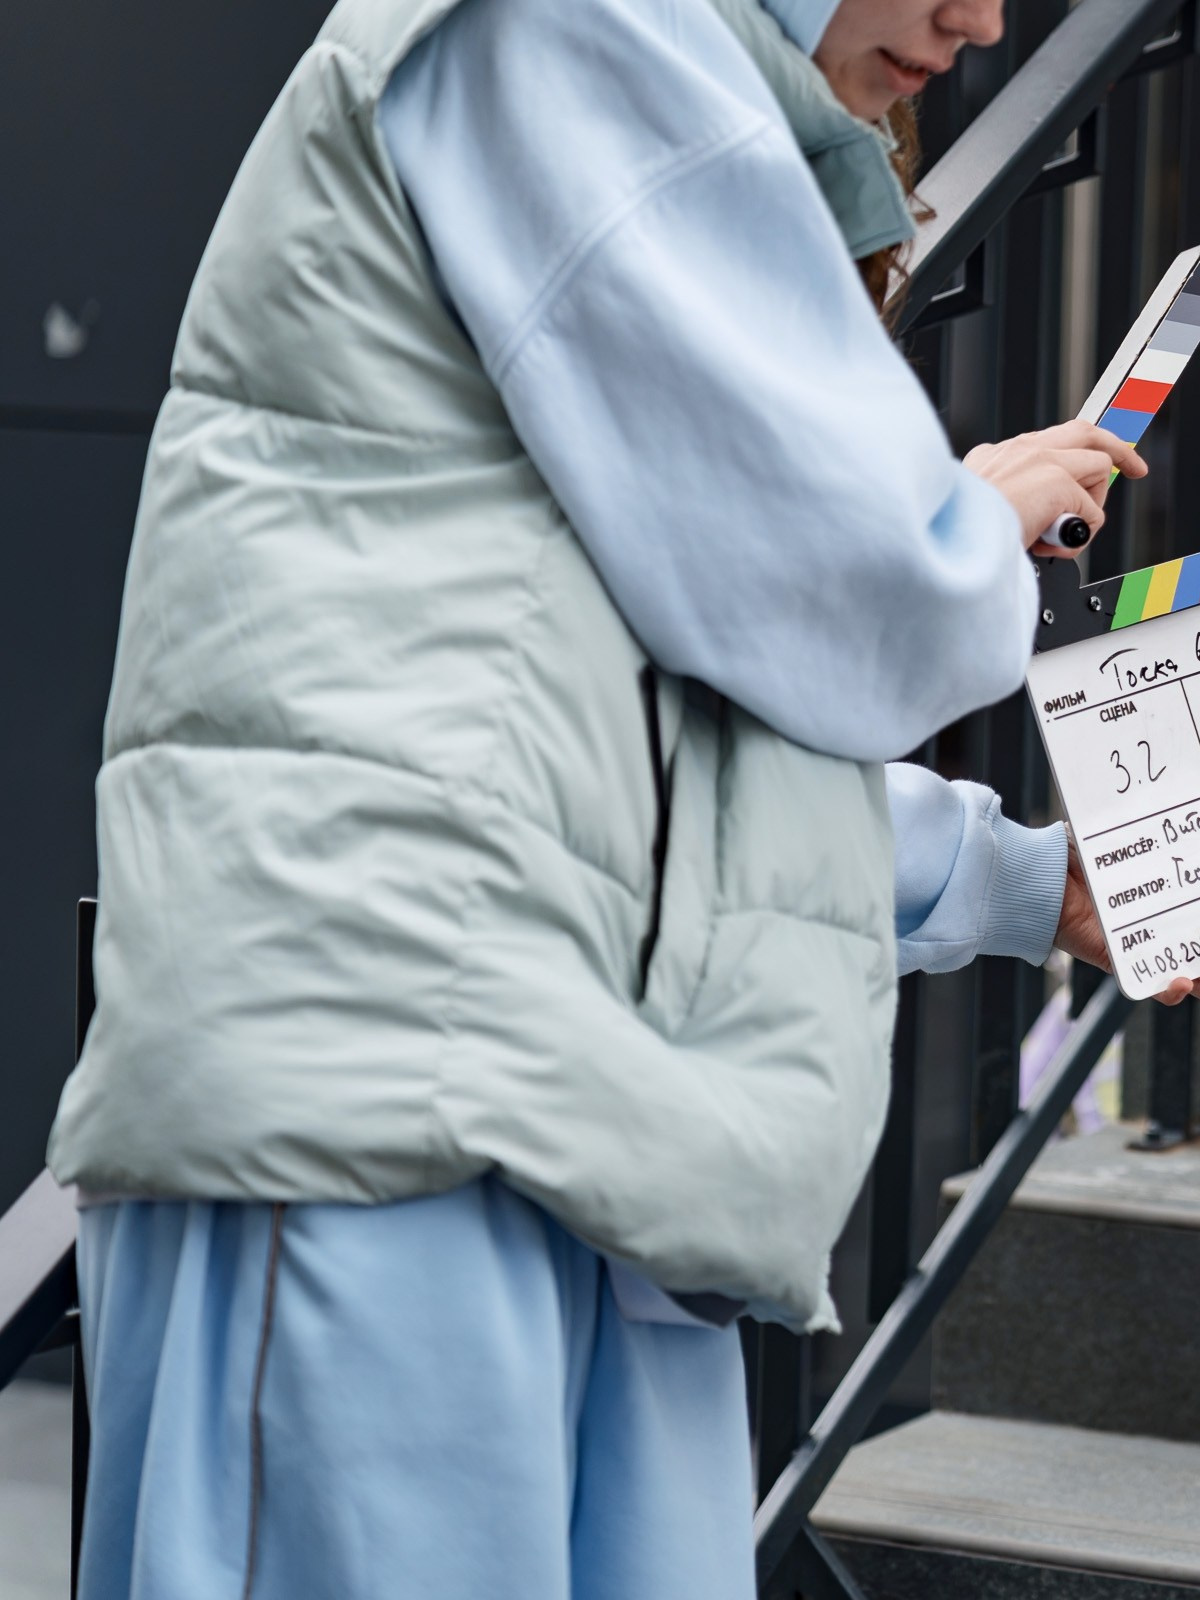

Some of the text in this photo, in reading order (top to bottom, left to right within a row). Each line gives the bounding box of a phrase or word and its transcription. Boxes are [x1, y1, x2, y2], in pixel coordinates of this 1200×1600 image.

[1044, 690, 1087, 714] ФИЛЬМ
[1100, 701, 1138, 723] СЦЕНА
[1110, 740, 1167, 794] 3.2
[1094, 838, 1160, 870] РЕЖИССЁР:
[1108, 877, 1171, 909] ОПЕРАТОР:
[1121, 928, 1156, 953] ДАТА:
